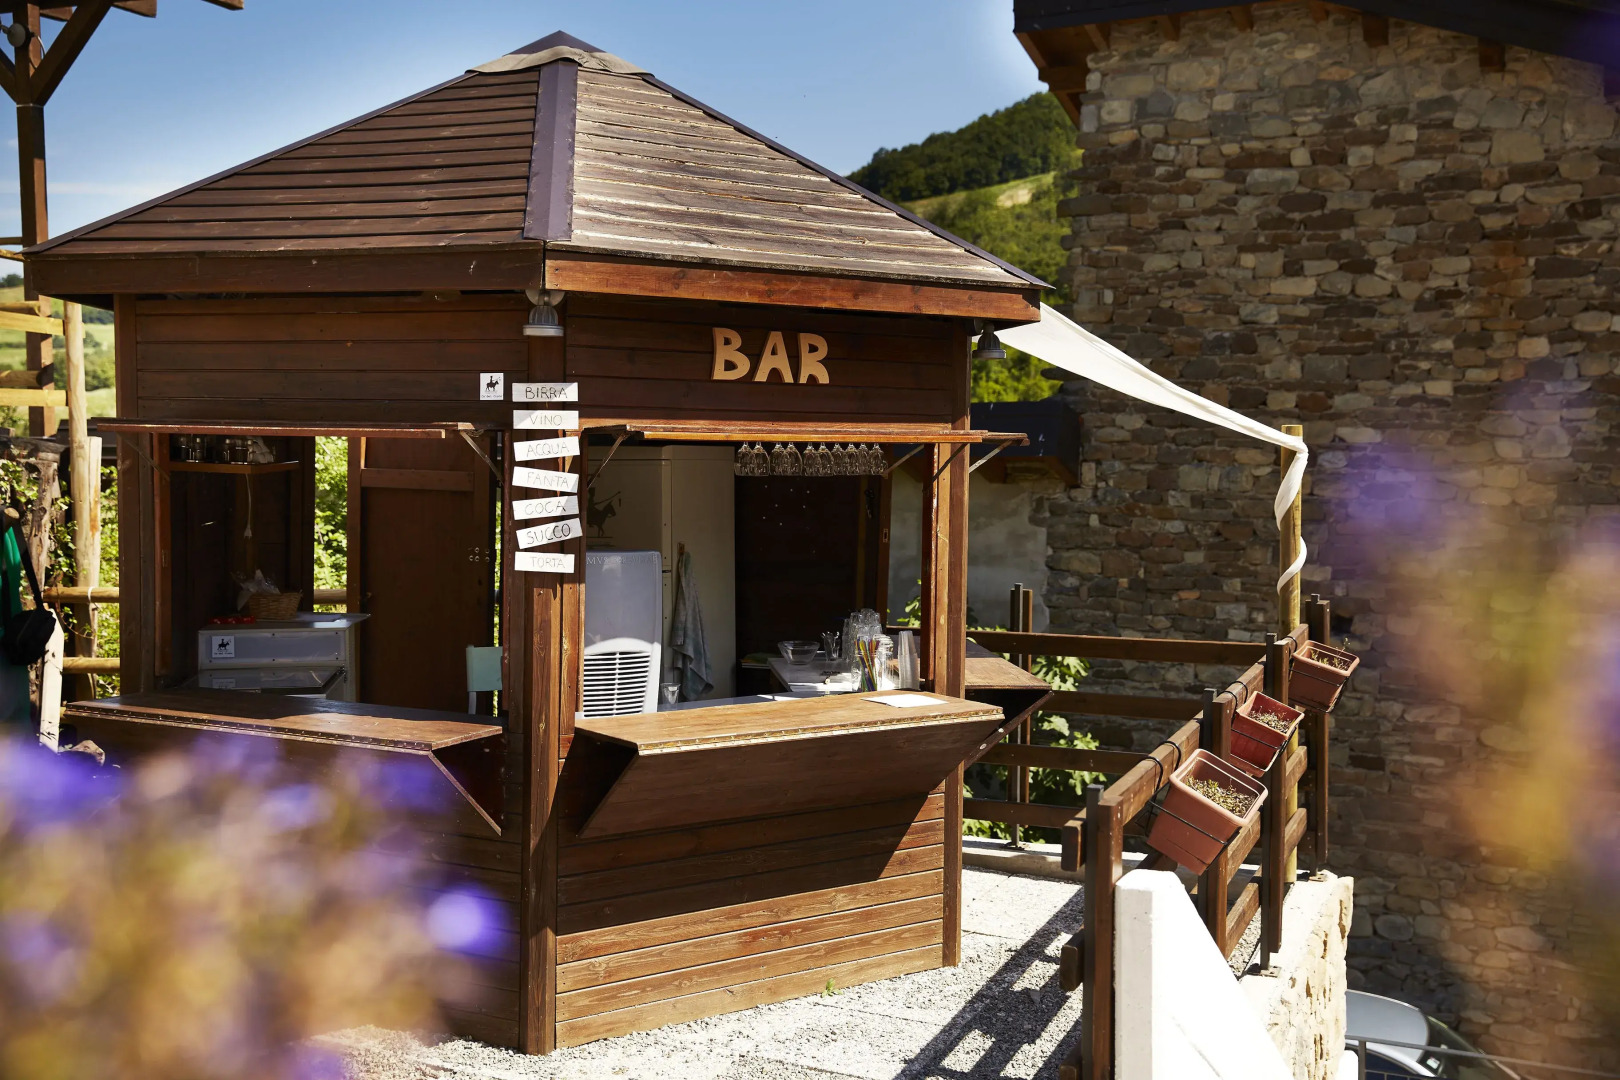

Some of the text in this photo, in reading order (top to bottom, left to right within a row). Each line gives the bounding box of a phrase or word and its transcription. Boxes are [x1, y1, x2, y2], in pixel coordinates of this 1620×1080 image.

[711, 327, 829, 384] BAR
[525, 387, 568, 399] BIRRA
[526, 442, 569, 457] ACQUA
[527, 472, 569, 488] FANTA
[525, 501, 566, 515] COCA
[526, 523, 571, 544] SUCCO
[530, 556, 566, 568] TORTA
